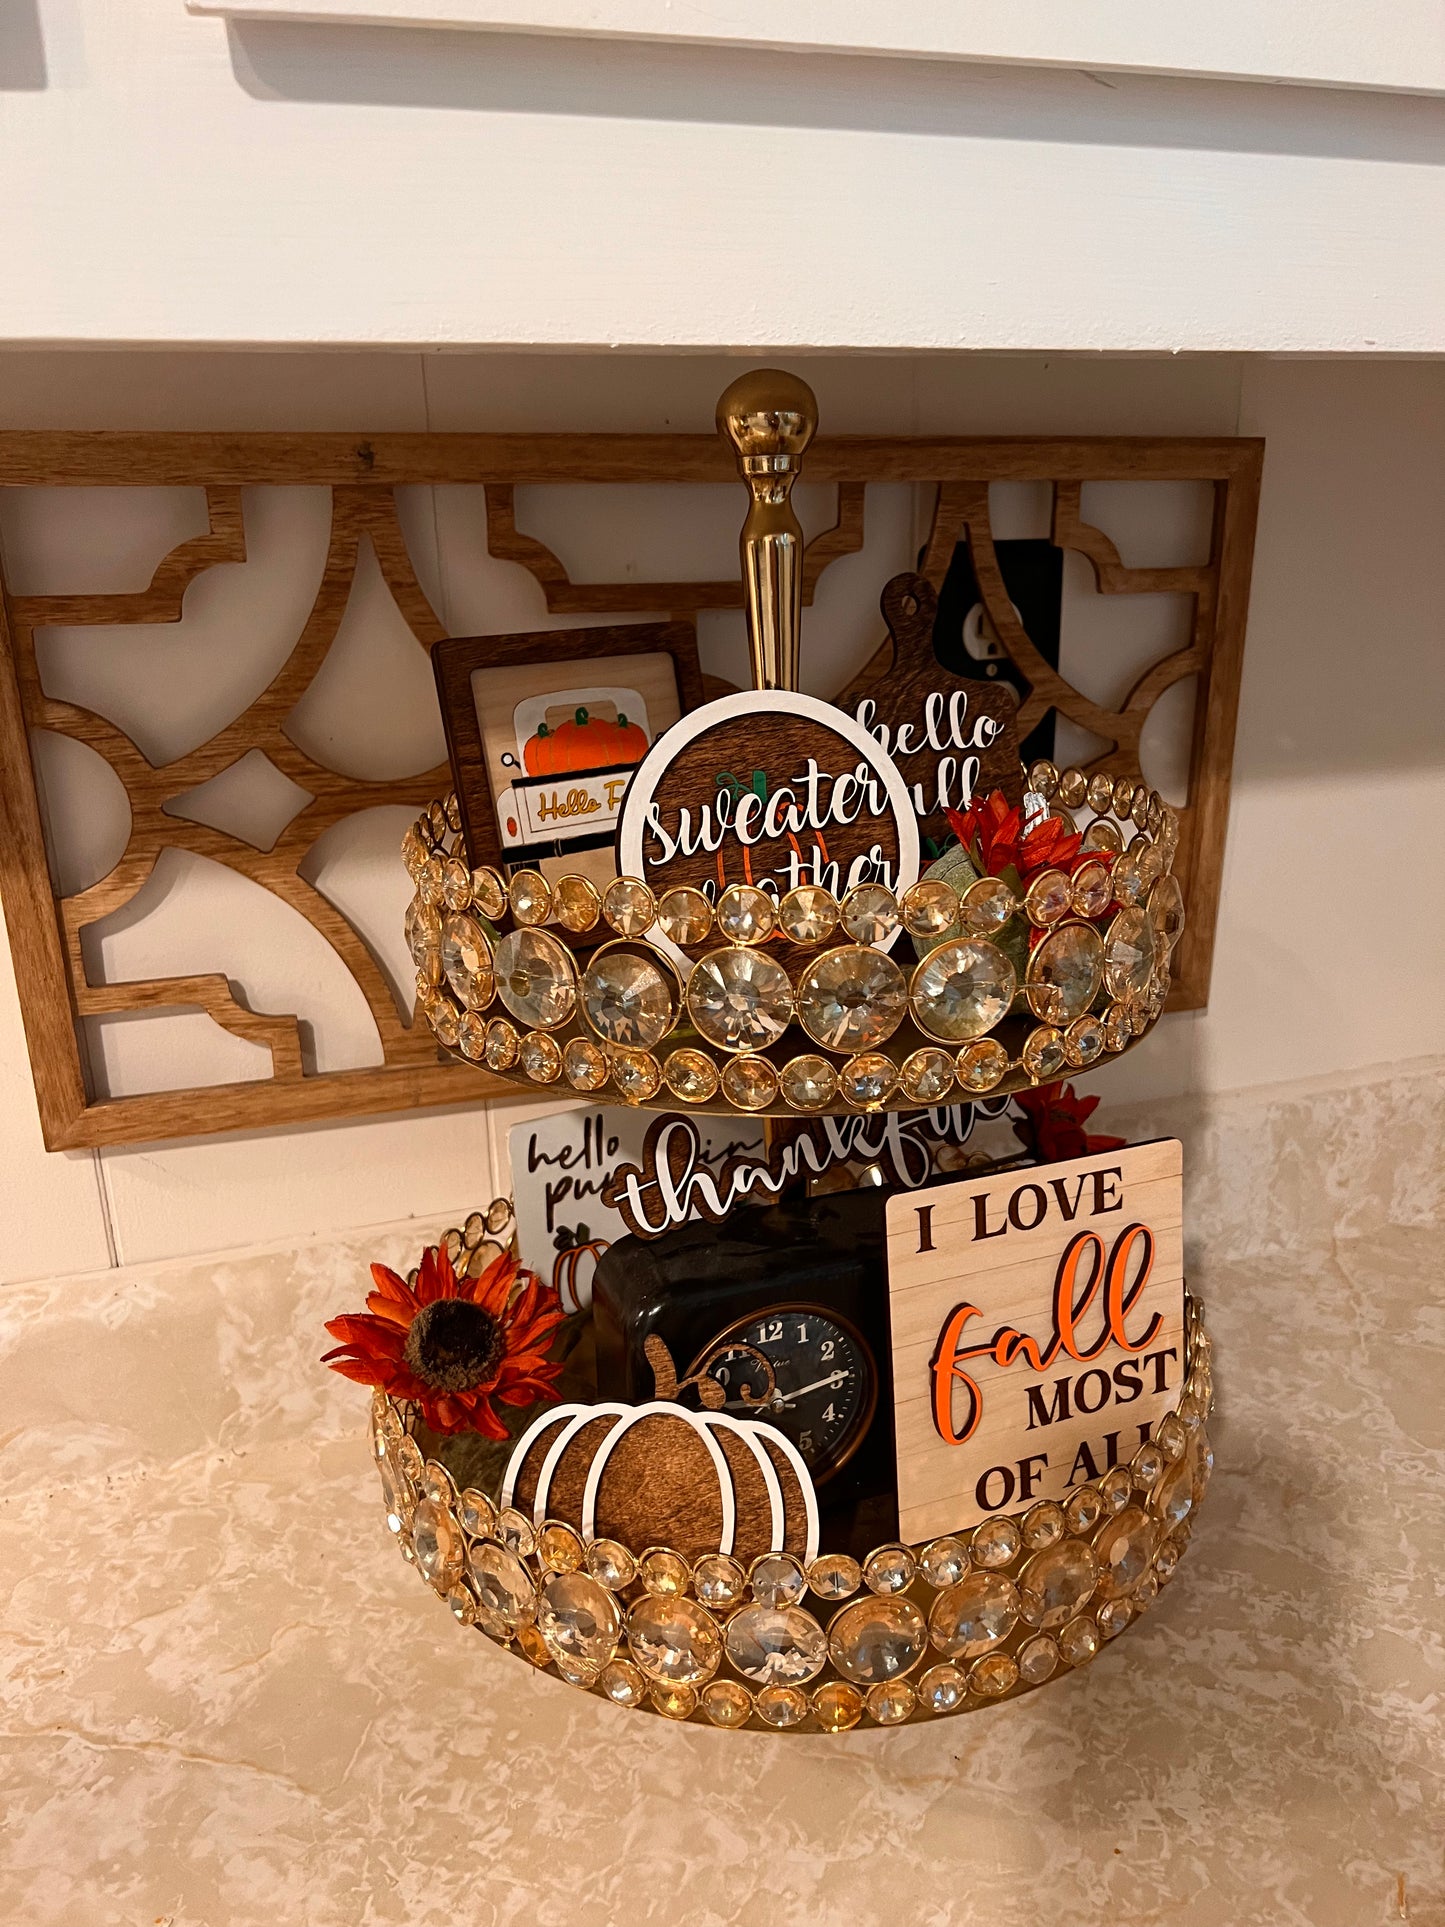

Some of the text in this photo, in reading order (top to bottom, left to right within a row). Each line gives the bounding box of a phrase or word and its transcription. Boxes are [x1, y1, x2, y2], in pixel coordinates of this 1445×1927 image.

[538, 788, 601, 822] Hello
[645, 758, 890, 865] sweater
[528, 1113, 620, 1173] hello
[913, 1165, 1124, 1255] I LOVE
[757, 1319, 783, 1345] 12
[796, 1322, 810, 1344] 1
[820, 1340, 835, 1361] 2
[928, 1222, 1165, 1446] fall
[821, 1402, 836, 1423] 4
[1024, 1347, 1178, 1431] MOST
[799, 1429, 813, 1451] 5
[975, 1452, 1049, 1512] OF
